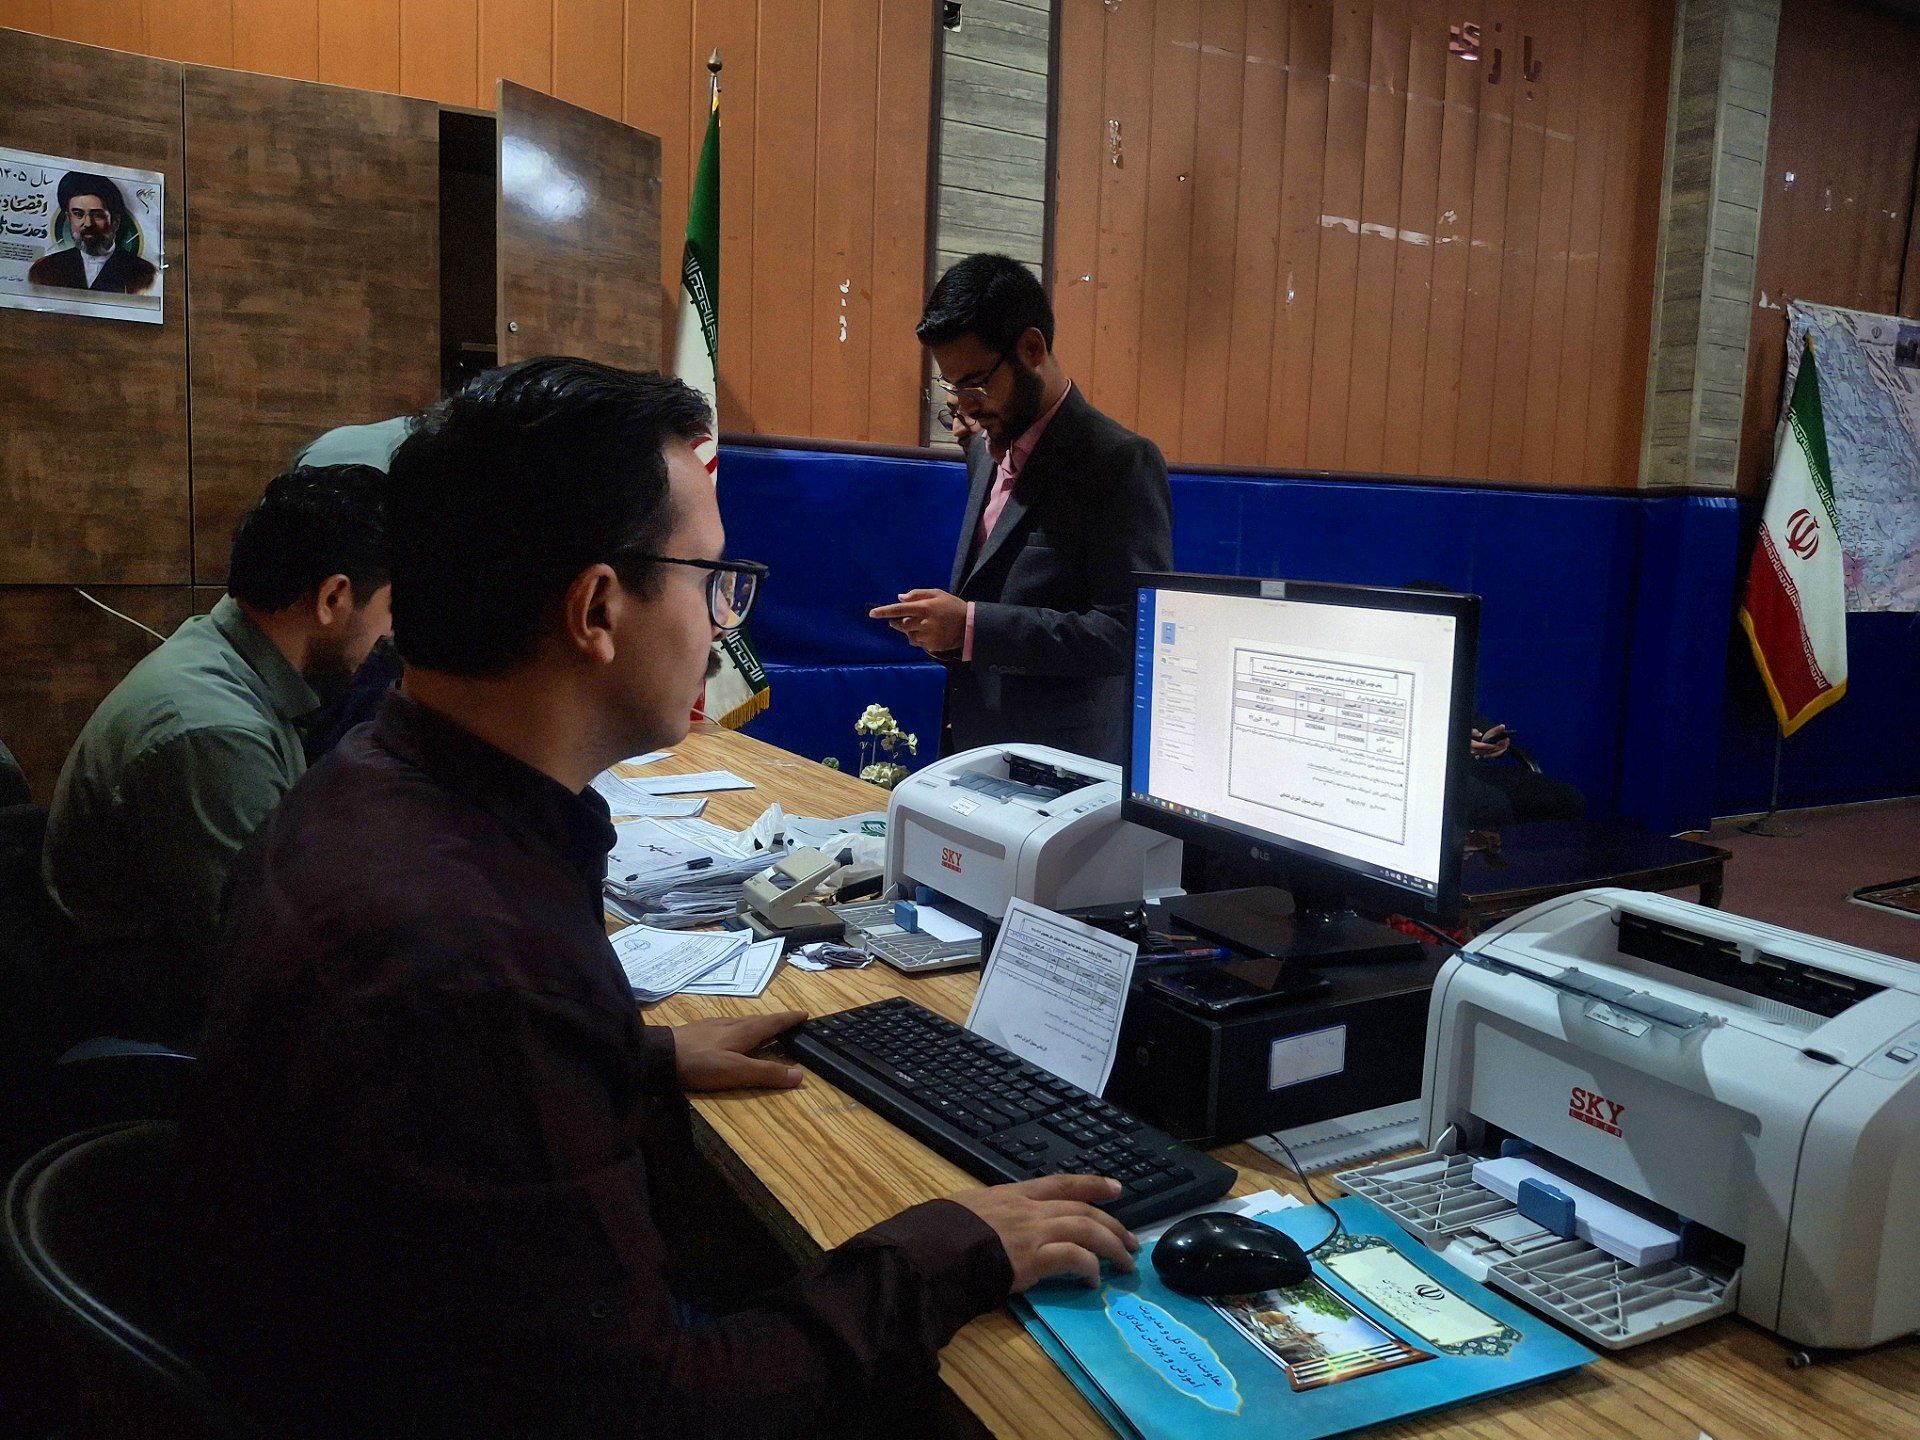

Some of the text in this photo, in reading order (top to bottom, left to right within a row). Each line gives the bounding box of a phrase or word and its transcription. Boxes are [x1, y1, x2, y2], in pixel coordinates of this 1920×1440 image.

[30, 169, 54, 188] سال
[5, 222, 49, 239] وحدت
[941, 847, 963, 867] SKY
[1569, 1086, 1626, 1126] SKY
[1138, 1304, 1165, 1329] مدیریت
[1141, 1333, 1169, 1358] پرورش
[1165, 1334, 1186, 1346] کل
[1179, 1346, 1202, 1363] اداره
[1170, 1363, 1207, 1389] آموزش
[1196, 1362, 1223, 1388] معاونت
